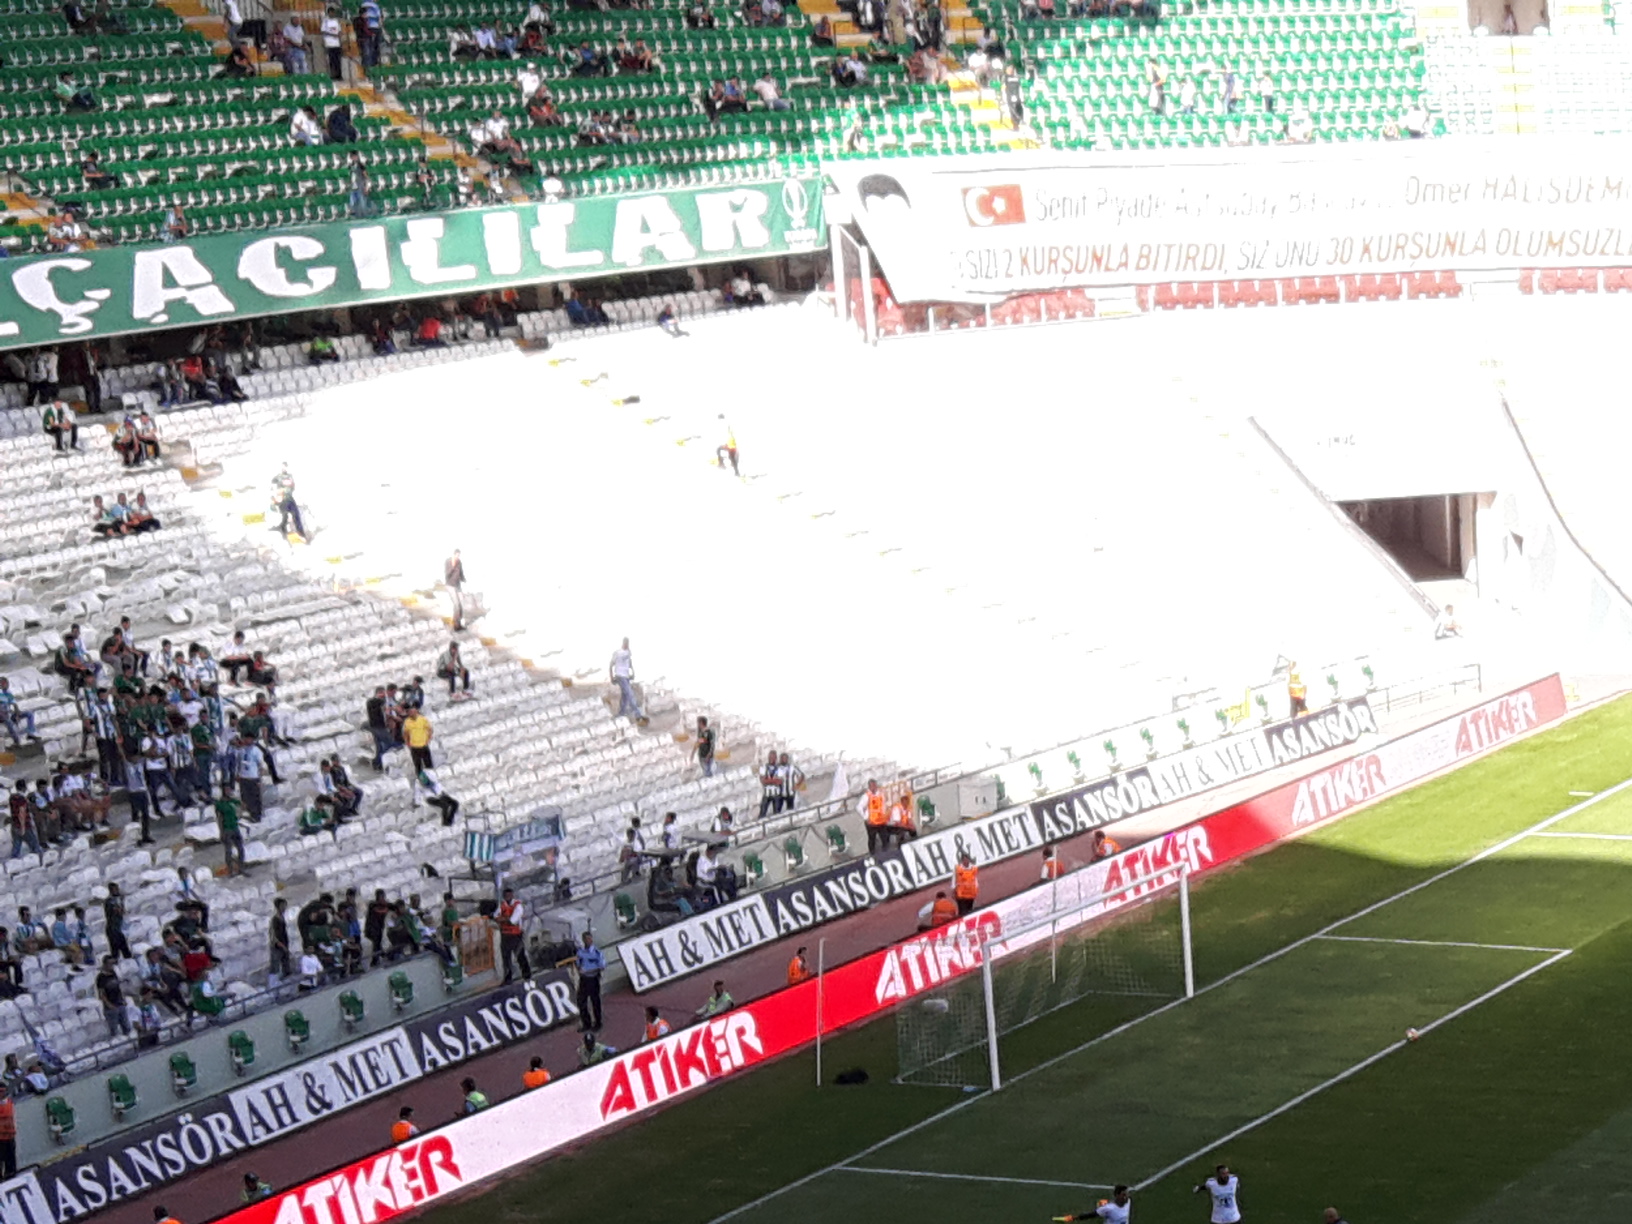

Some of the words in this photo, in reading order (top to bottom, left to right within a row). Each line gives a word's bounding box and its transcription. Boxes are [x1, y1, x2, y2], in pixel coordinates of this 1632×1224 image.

[0, 187, 770, 336] ÇACILILAR
[1002, 247, 1014, 278] 2
[1326, 235, 1354, 265] 30
[1214, 738, 1262, 782] MET
[911, 840, 950, 885] AH
[953, 832, 976, 863] &
[976, 812, 1034, 860] MET
[1042, 775, 1159, 841] ASANSÖR
[630, 935, 677, 986] AH
[679, 920, 702, 966] &
[701, 903, 769, 959] MET
[772, 858, 910, 930] ASANSÖR
[55, 1113, 244, 1223] ASANSÖR
[243, 1082, 300, 1143] AH
[302, 1071, 335, 1115] &
[336, 1037, 409, 1102] MET
[421, 981, 580, 1071] ASANSÖR
